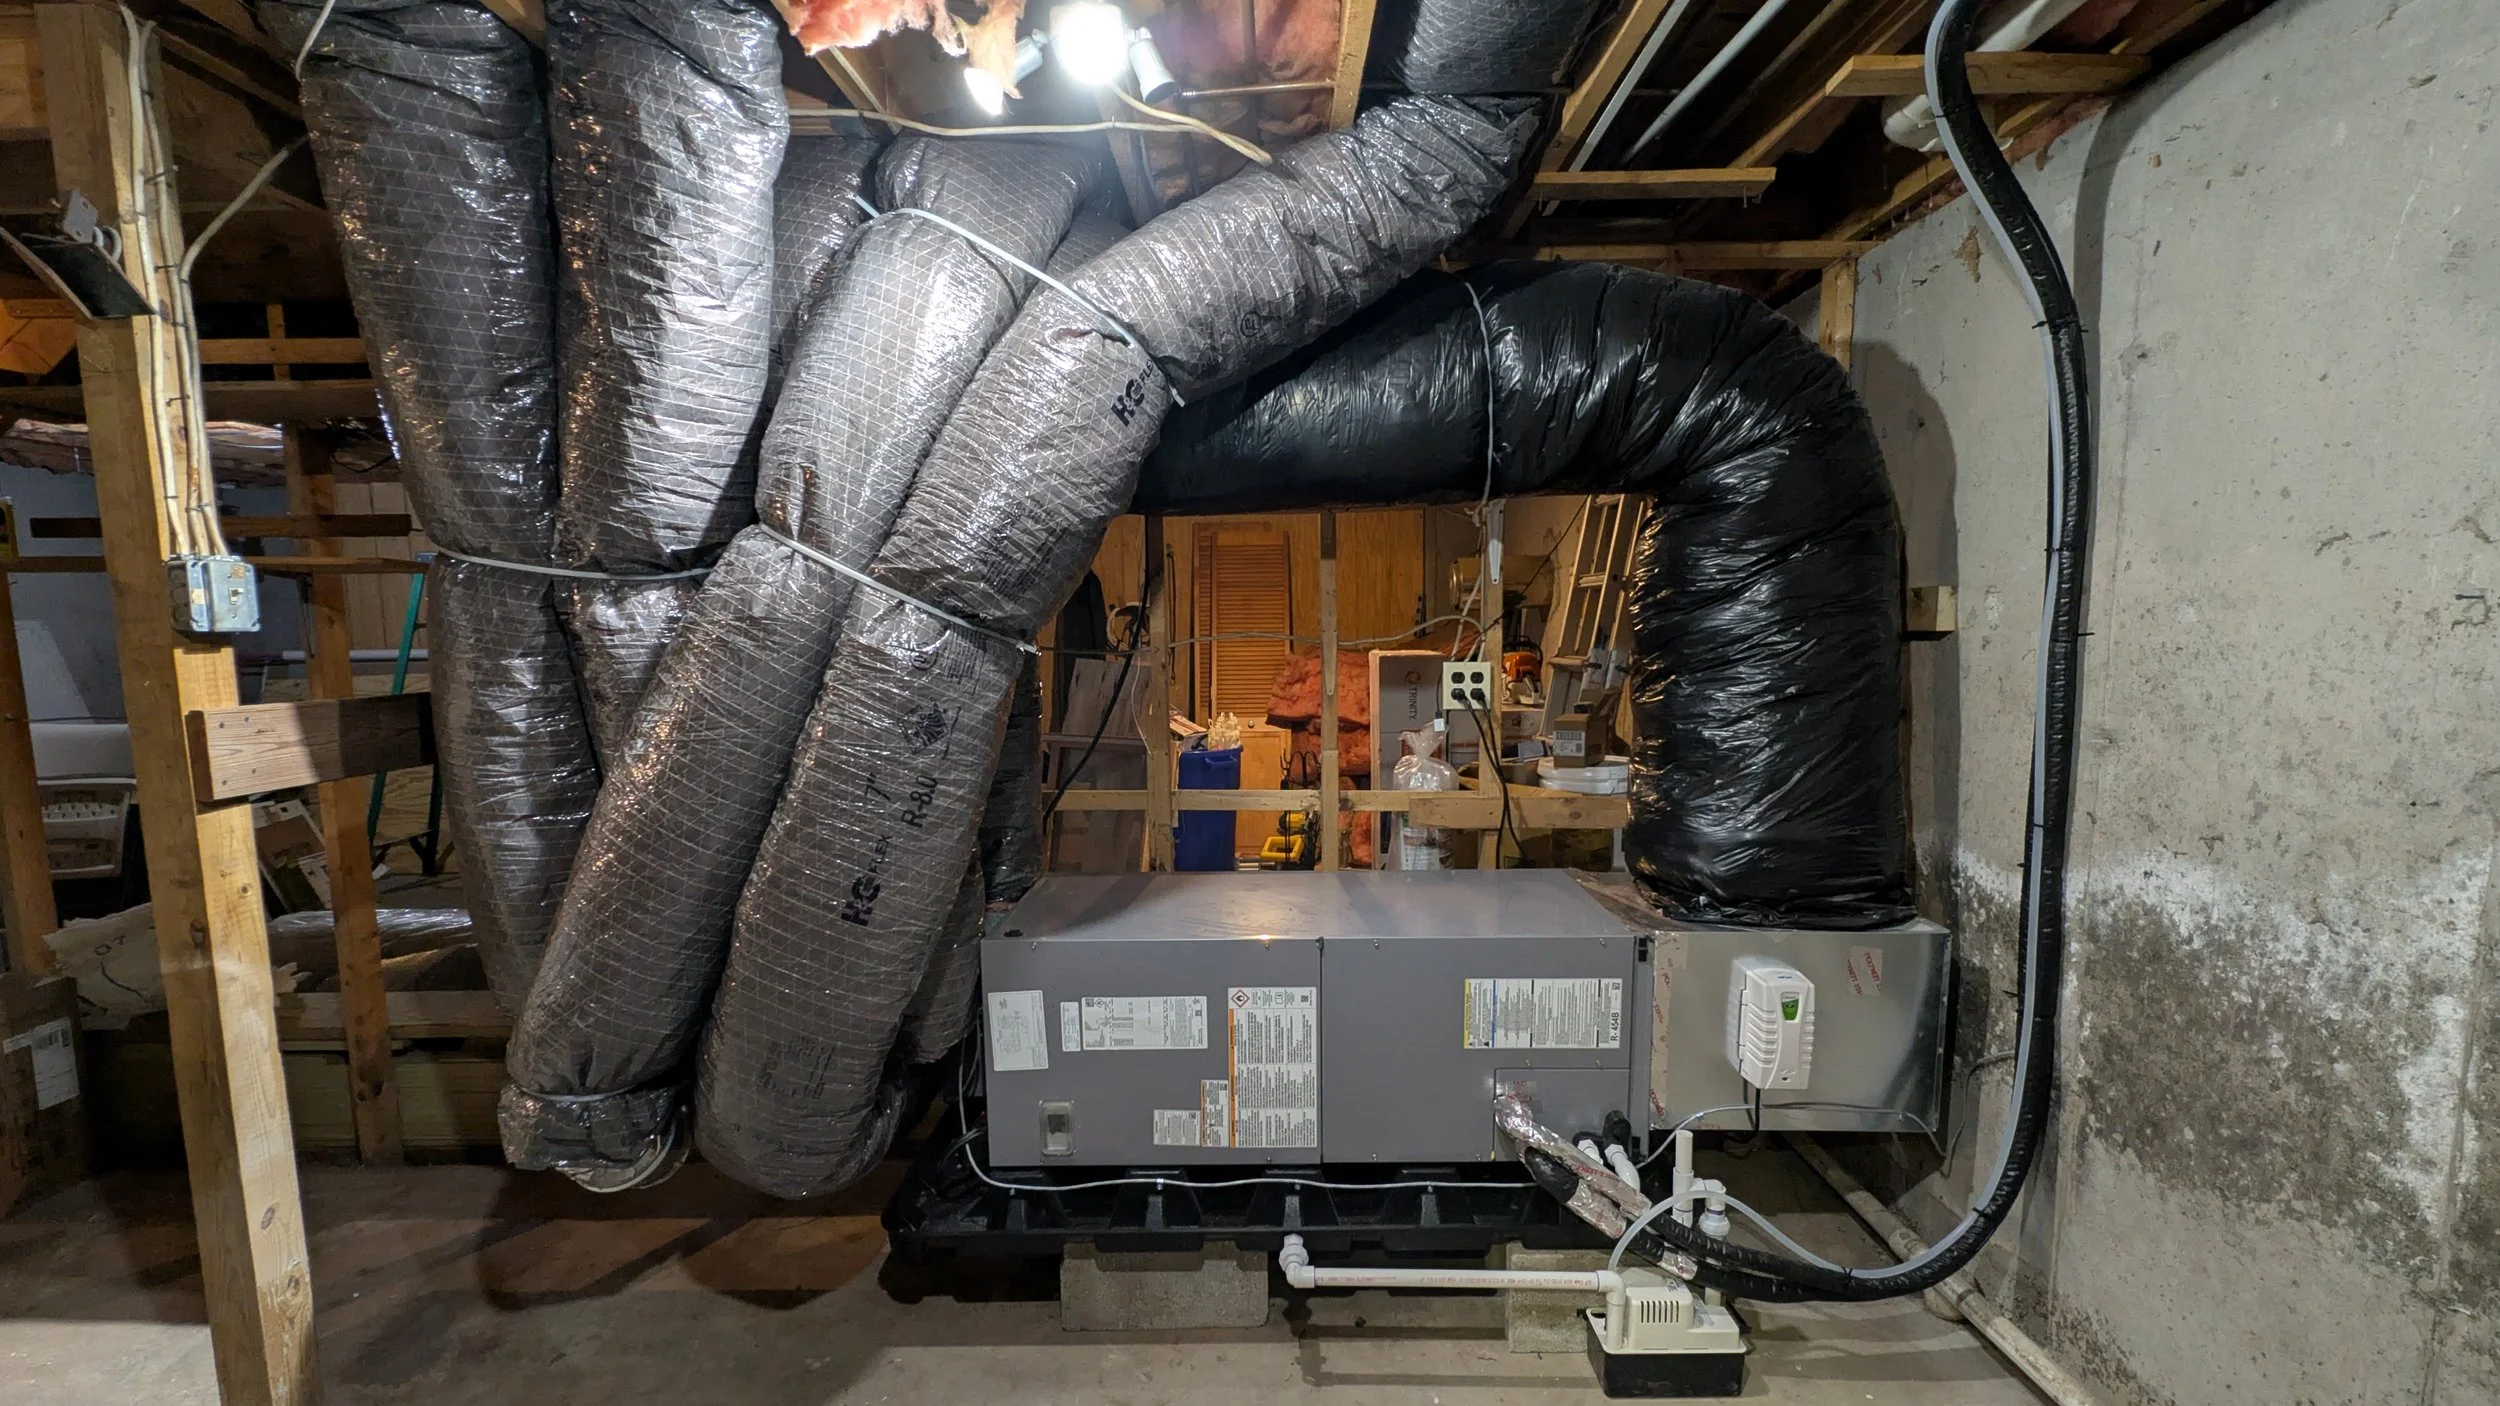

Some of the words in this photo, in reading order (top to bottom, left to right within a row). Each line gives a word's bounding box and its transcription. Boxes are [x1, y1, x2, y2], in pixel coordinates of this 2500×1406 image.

[1409, 687, 1417, 721] TRINITY
[901, 775, 938, 828] R-8.0
[868, 835, 893, 874] FLEX
